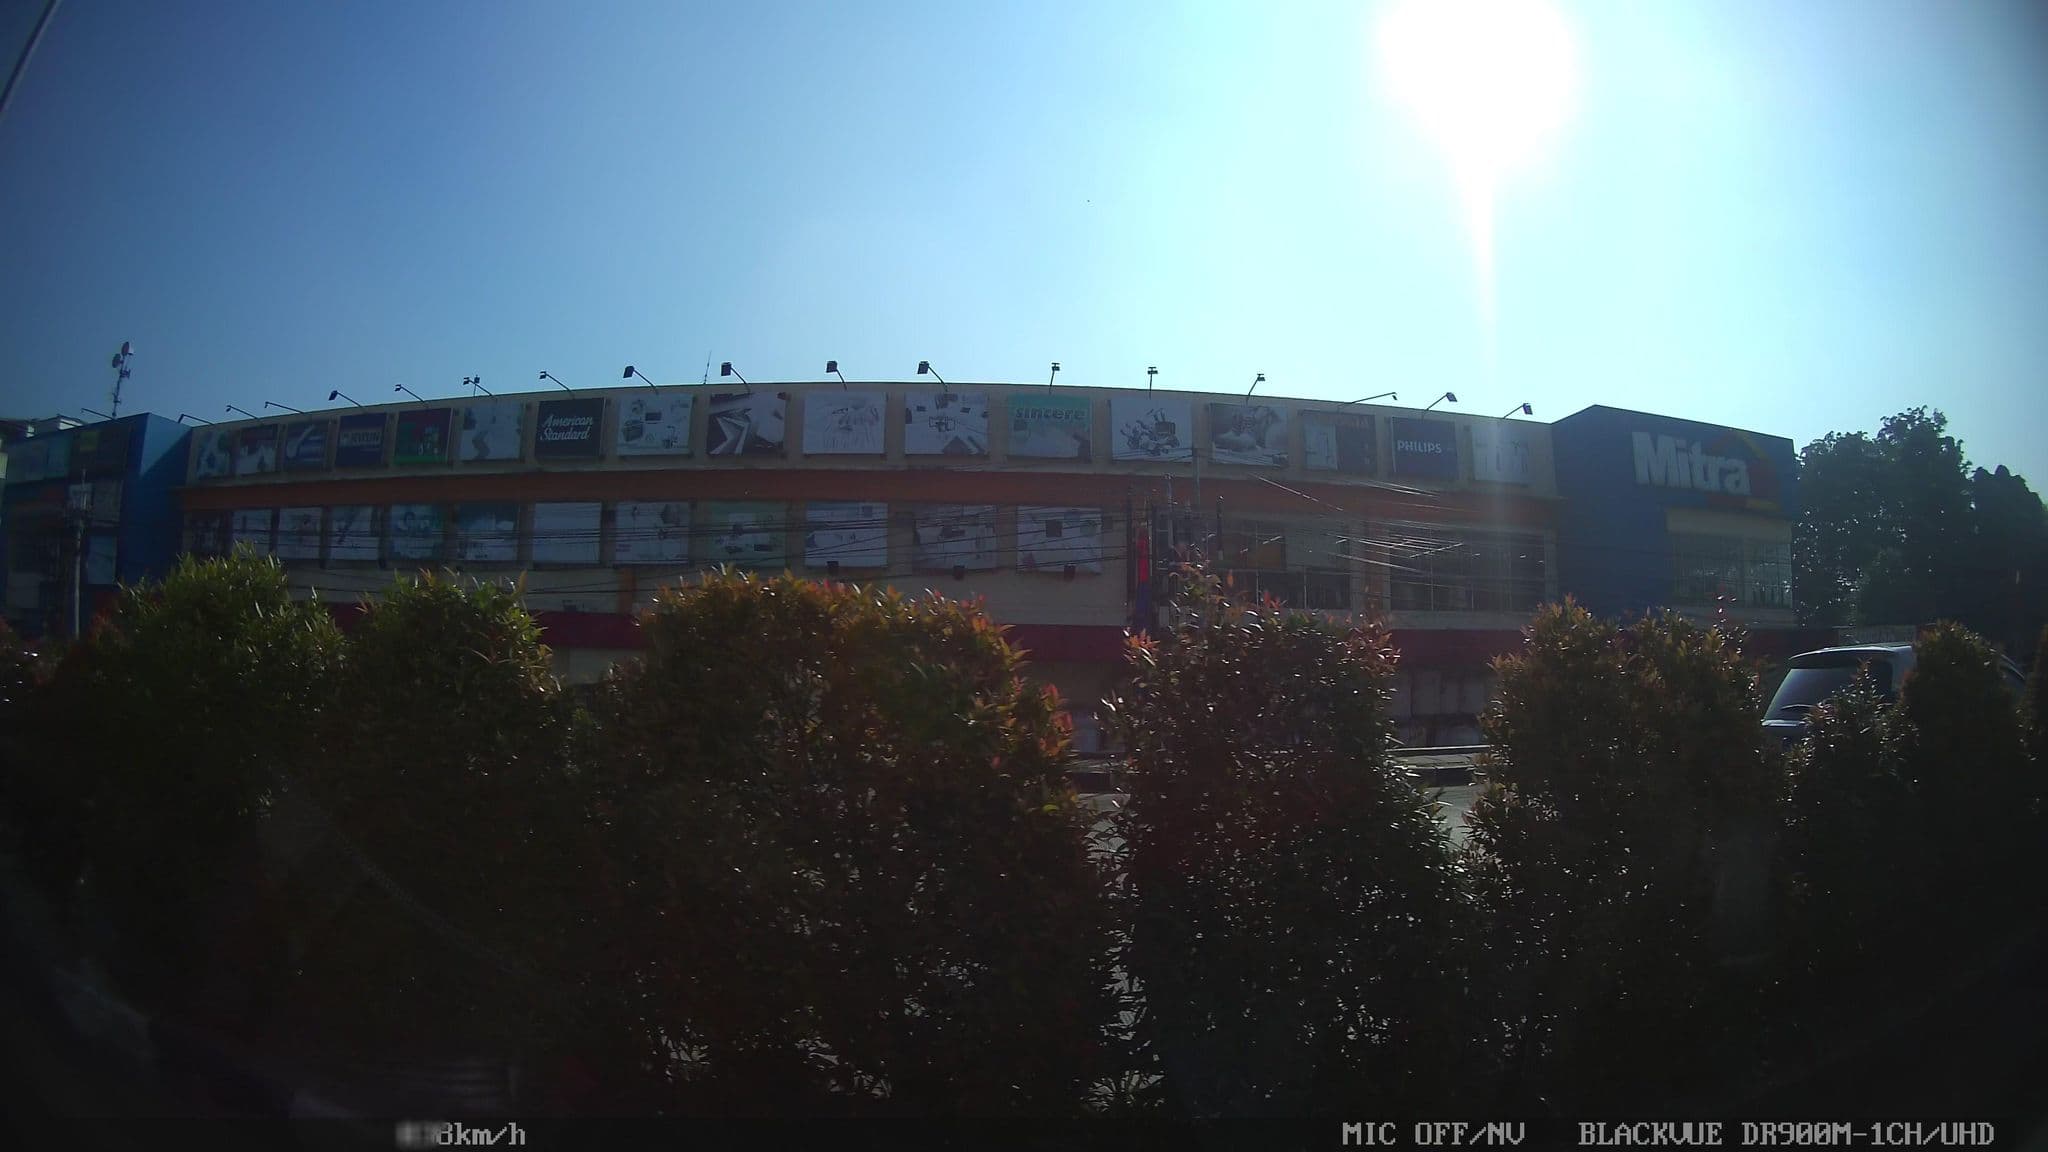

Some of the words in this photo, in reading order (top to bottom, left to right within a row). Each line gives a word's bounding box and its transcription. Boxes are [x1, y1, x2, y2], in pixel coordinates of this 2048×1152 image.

[541, 413, 593, 427] American
[1015, 407, 1086, 421] sincere
[540, 426, 590, 441] Standard
[1396, 439, 1443, 454] PHILIPS
[1631, 431, 1751, 496] Mitra
